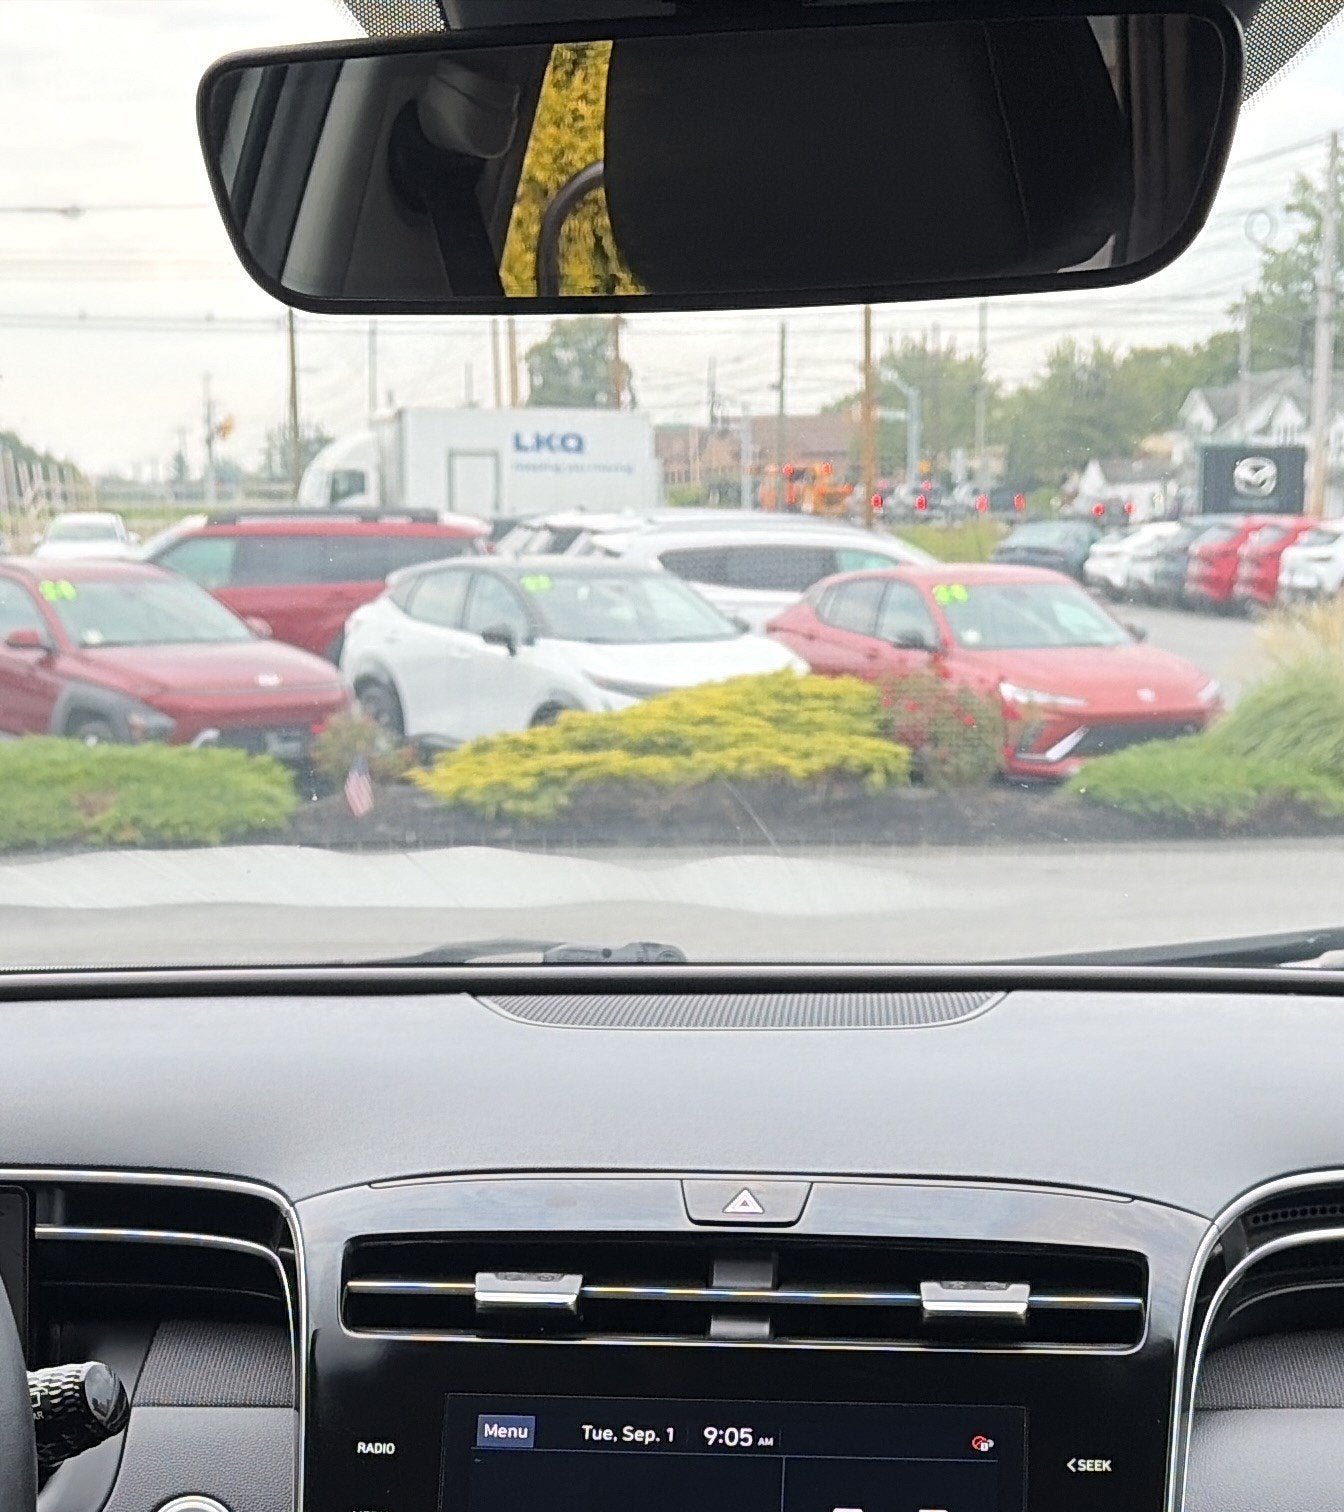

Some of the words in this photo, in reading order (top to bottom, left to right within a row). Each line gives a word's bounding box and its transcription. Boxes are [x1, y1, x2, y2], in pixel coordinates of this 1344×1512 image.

[513, 432, 583, 453] LKQ
[483, 1423, 529, 1440] Menu
[581, 1424, 618, 1442] Tue,
[622, 1425, 660, 1445] Sep.
[666, 1427, 675, 1442] 1
[703, 1426, 753, 1446] 9:05
[757, 1436, 774, 1446] AM
[357, 1441, 396, 1454] RADIO
